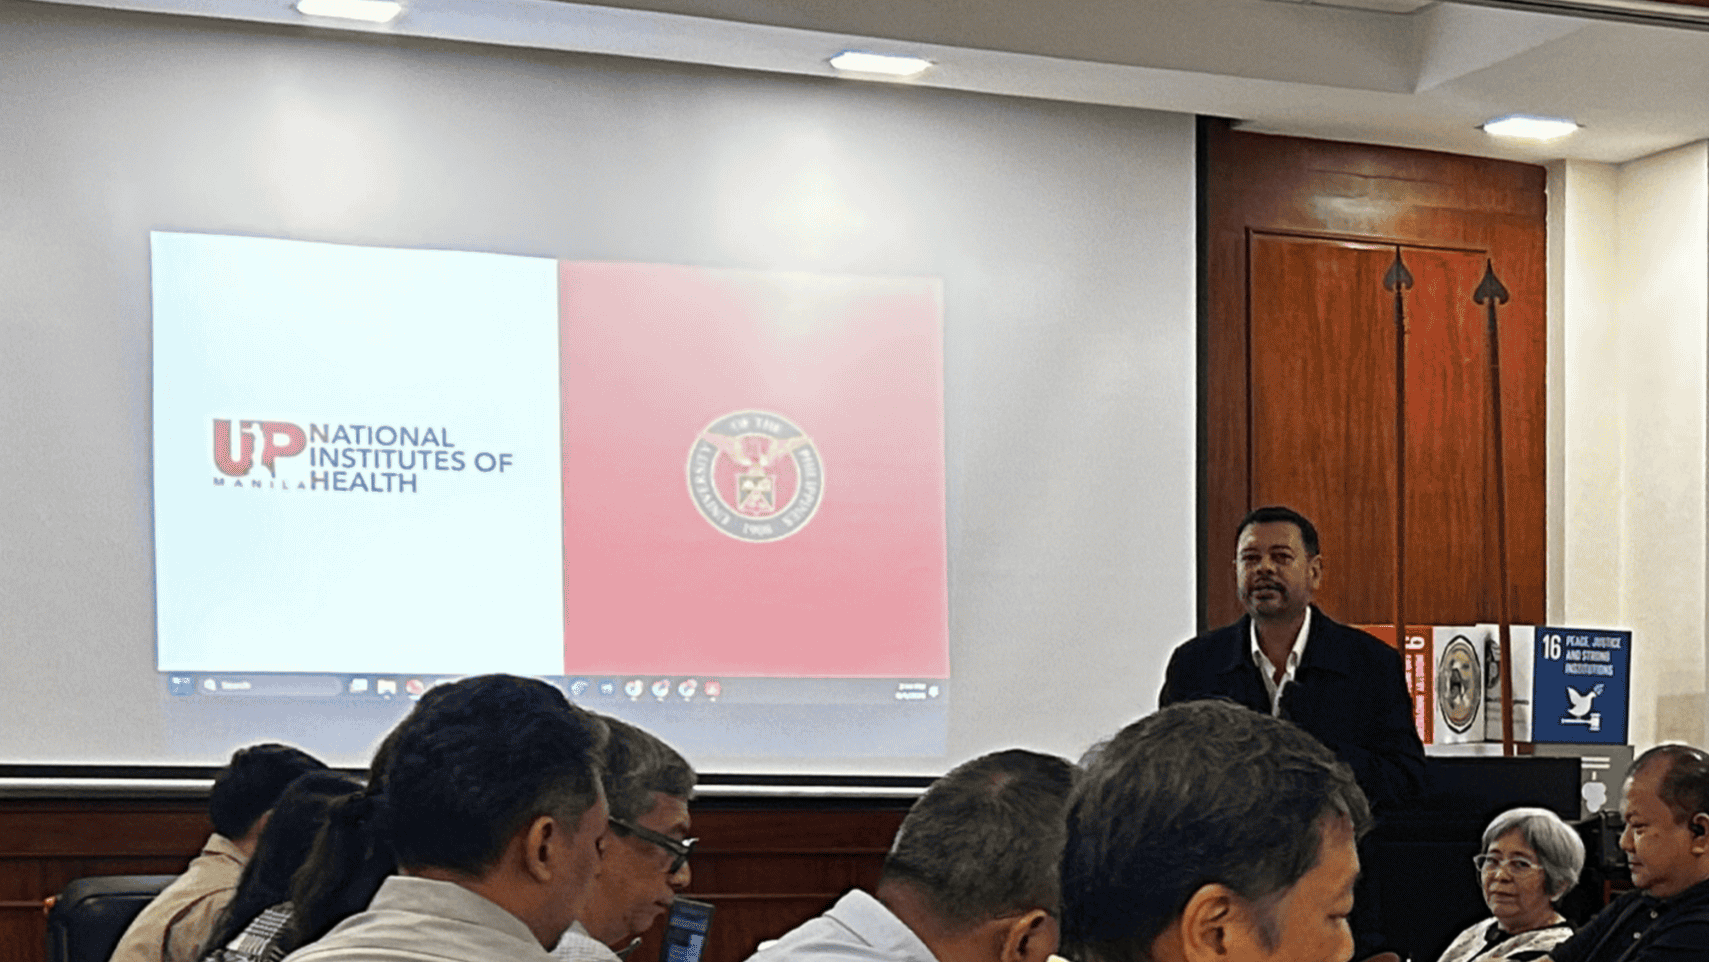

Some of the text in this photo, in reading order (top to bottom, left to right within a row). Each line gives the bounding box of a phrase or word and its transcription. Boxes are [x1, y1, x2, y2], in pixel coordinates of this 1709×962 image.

[213, 419, 307, 477] UP
[310, 423, 455, 448] NATIONAL
[310, 447, 513, 473] INSTITUTES OF
[213, 477, 306, 490] MANILA
[310, 470, 417, 493] HEALTH
[1543, 634, 1562, 660] 16
[1566, 650, 1581, 661] AND
